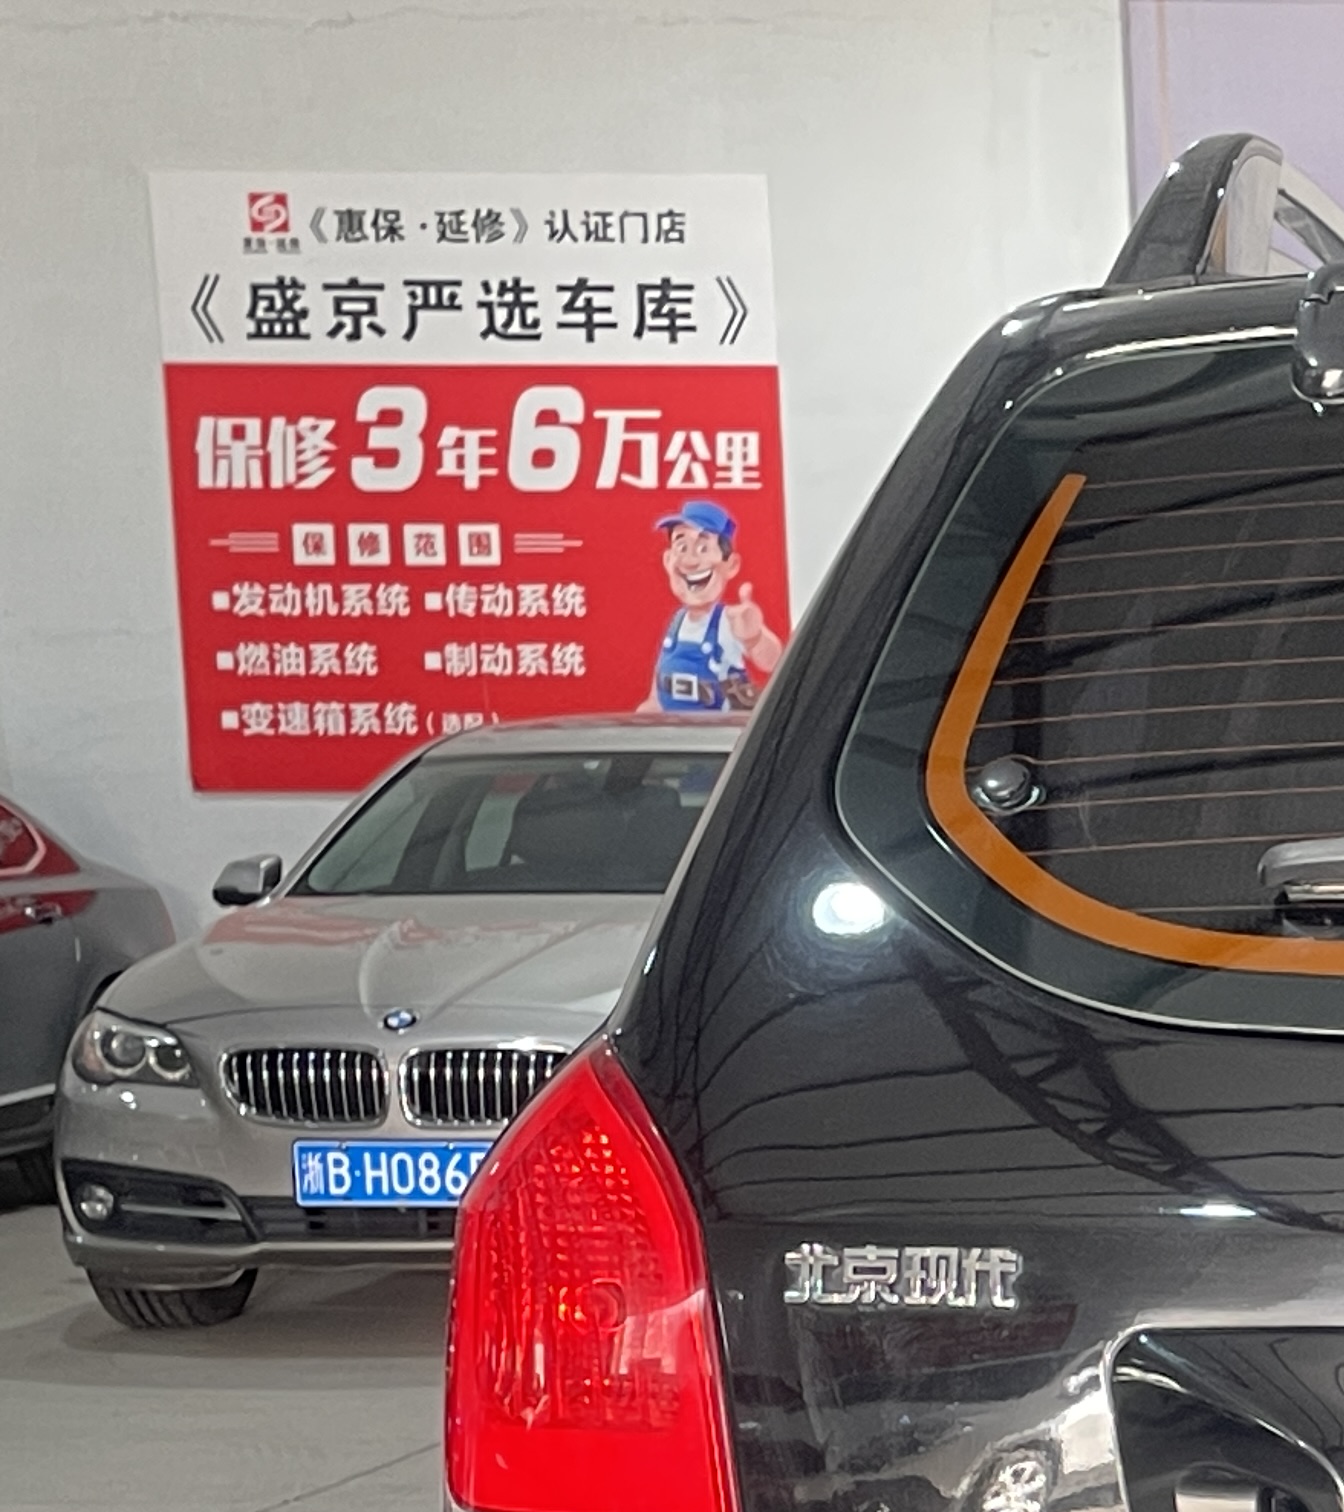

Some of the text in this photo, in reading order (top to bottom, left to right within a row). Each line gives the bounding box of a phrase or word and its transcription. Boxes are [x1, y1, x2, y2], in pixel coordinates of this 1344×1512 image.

[190, 274, 750, 346] 《盛京严选车库》
[231, 581, 587, 618] 发动机系统 传动系统
[236, 641, 587, 677] 燃油系统 制动系统
[783, 1243, 1022, 1309] 北京现代
